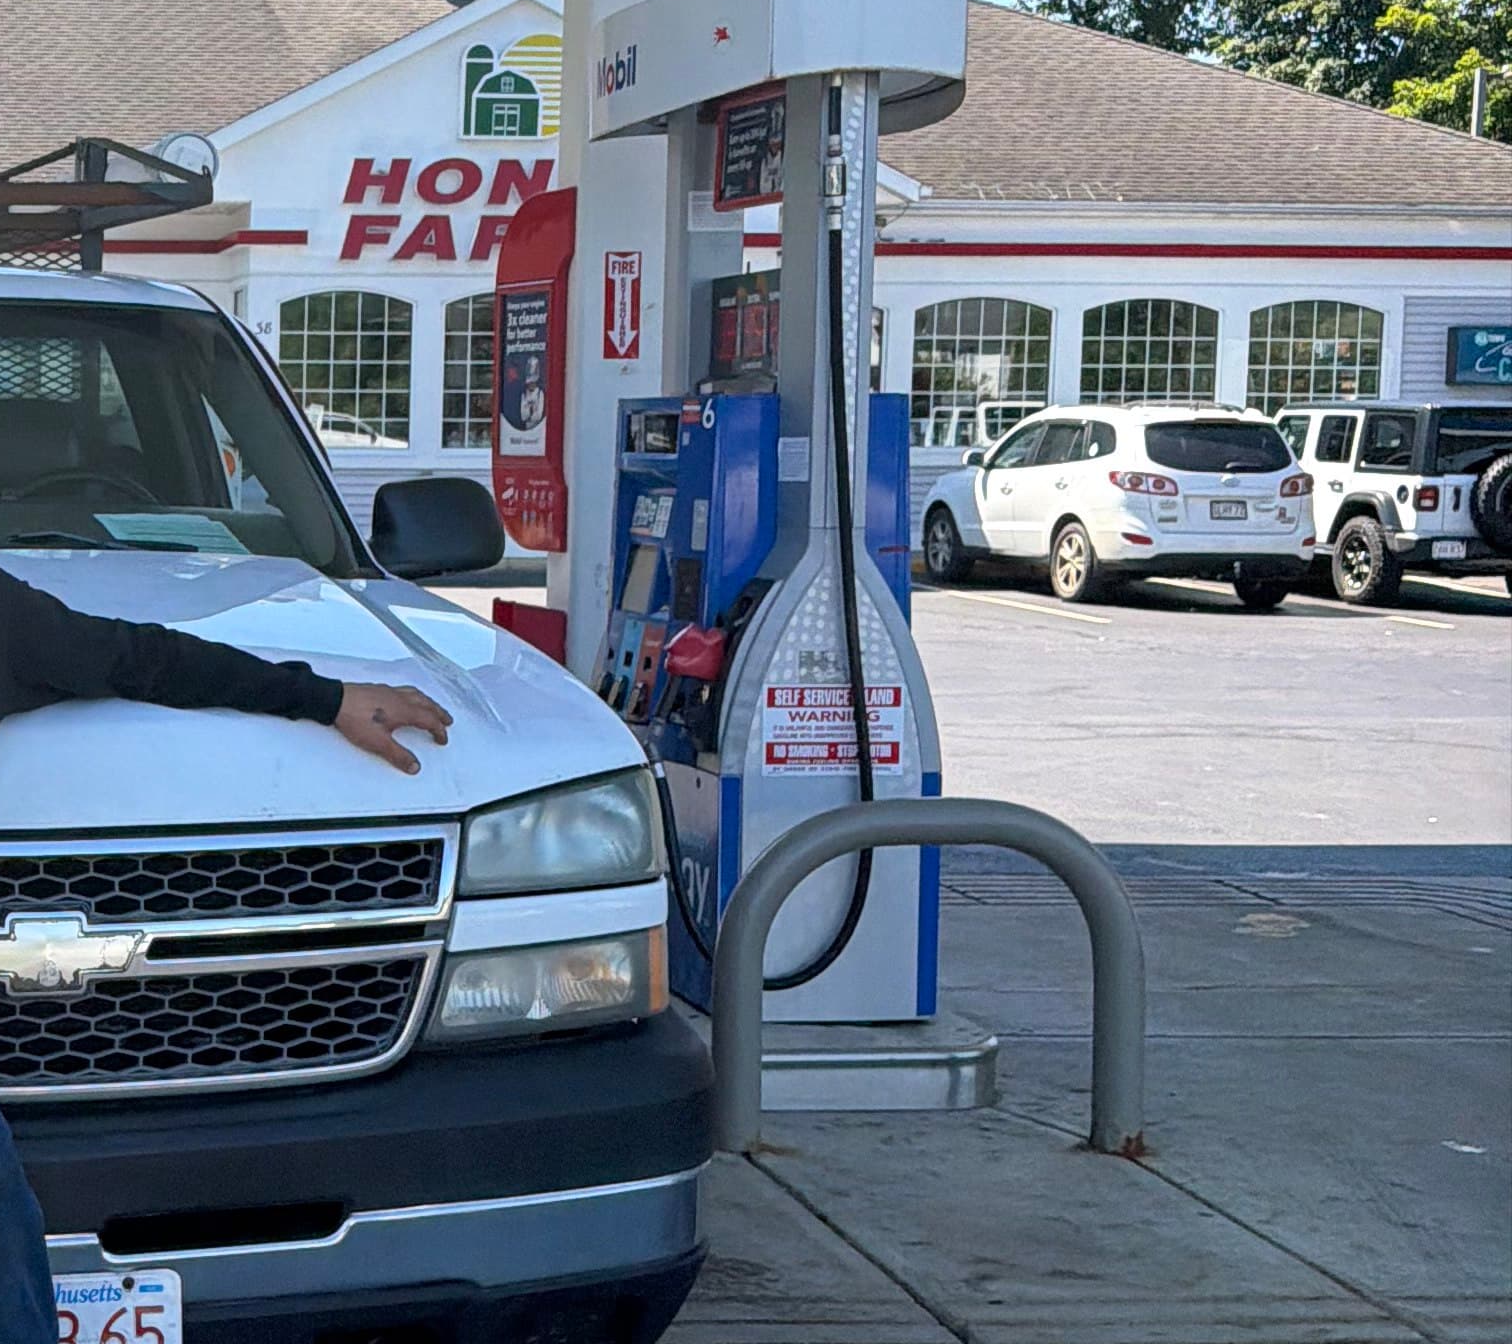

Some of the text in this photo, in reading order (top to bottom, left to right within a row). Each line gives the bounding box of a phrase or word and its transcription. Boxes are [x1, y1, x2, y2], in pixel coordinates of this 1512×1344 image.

[597, 44, 638, 98] Mobil
[342, 157, 556, 206] HON
[611, 260, 636, 275] FIRE
[508, 310, 548, 327] 3x cleaner
[702, 398, 715, 430] 6
[774, 688, 802, 706] SELF
[803, 688, 850, 706] SERVICE
[787, 710, 881, 723] WARNIG
